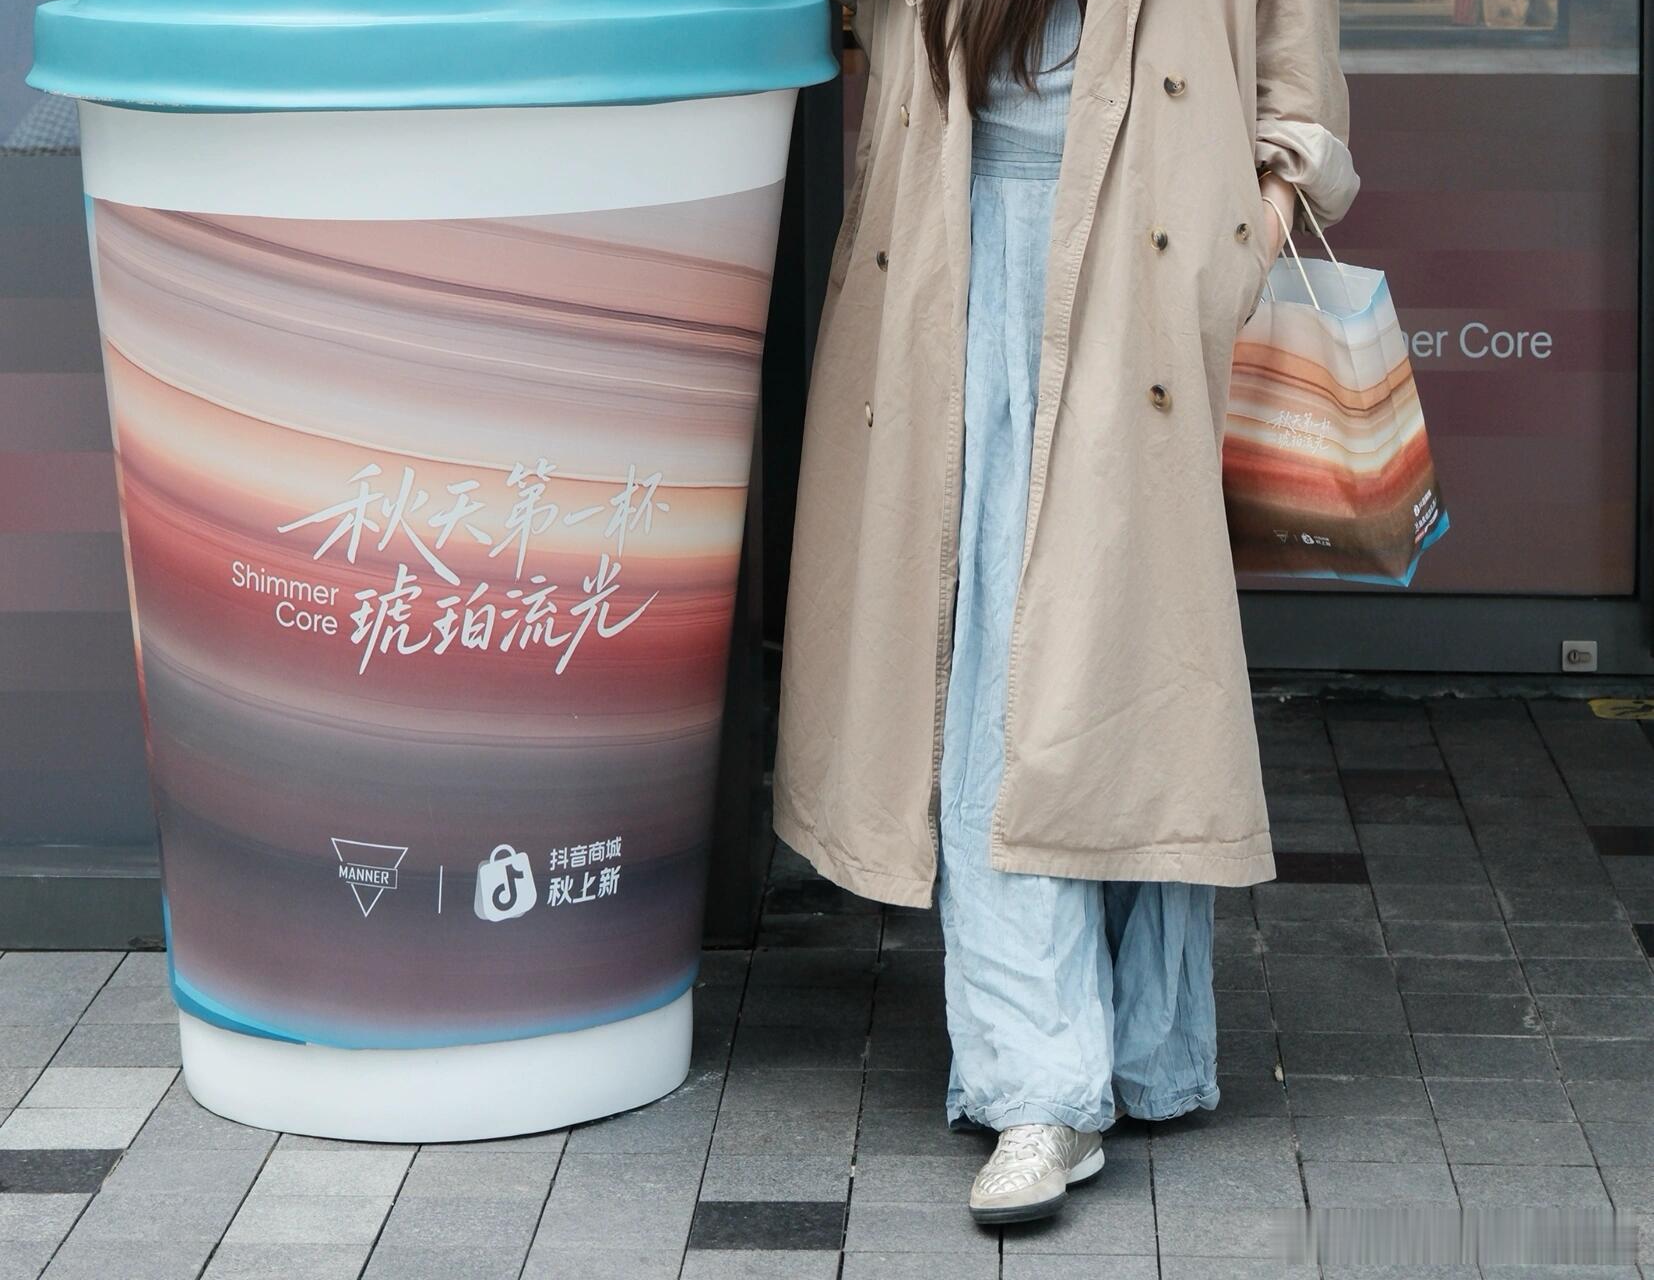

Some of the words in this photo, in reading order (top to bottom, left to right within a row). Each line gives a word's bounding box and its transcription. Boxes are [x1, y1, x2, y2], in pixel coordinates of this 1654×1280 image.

[1401, 329, 1449, 358] er
[1459, 321, 1553, 359] Core
[277, 458, 670, 585] 秋天第一杯
[231, 560, 340, 606] Shimmer
[276, 601, 338, 635] Core
[350, 553, 660, 675] 琥珀流光
[549, 836, 622, 871] 抖音商城
[339, 864, 390, 885] MANNER
[546, 865, 622, 907] 秋上新
